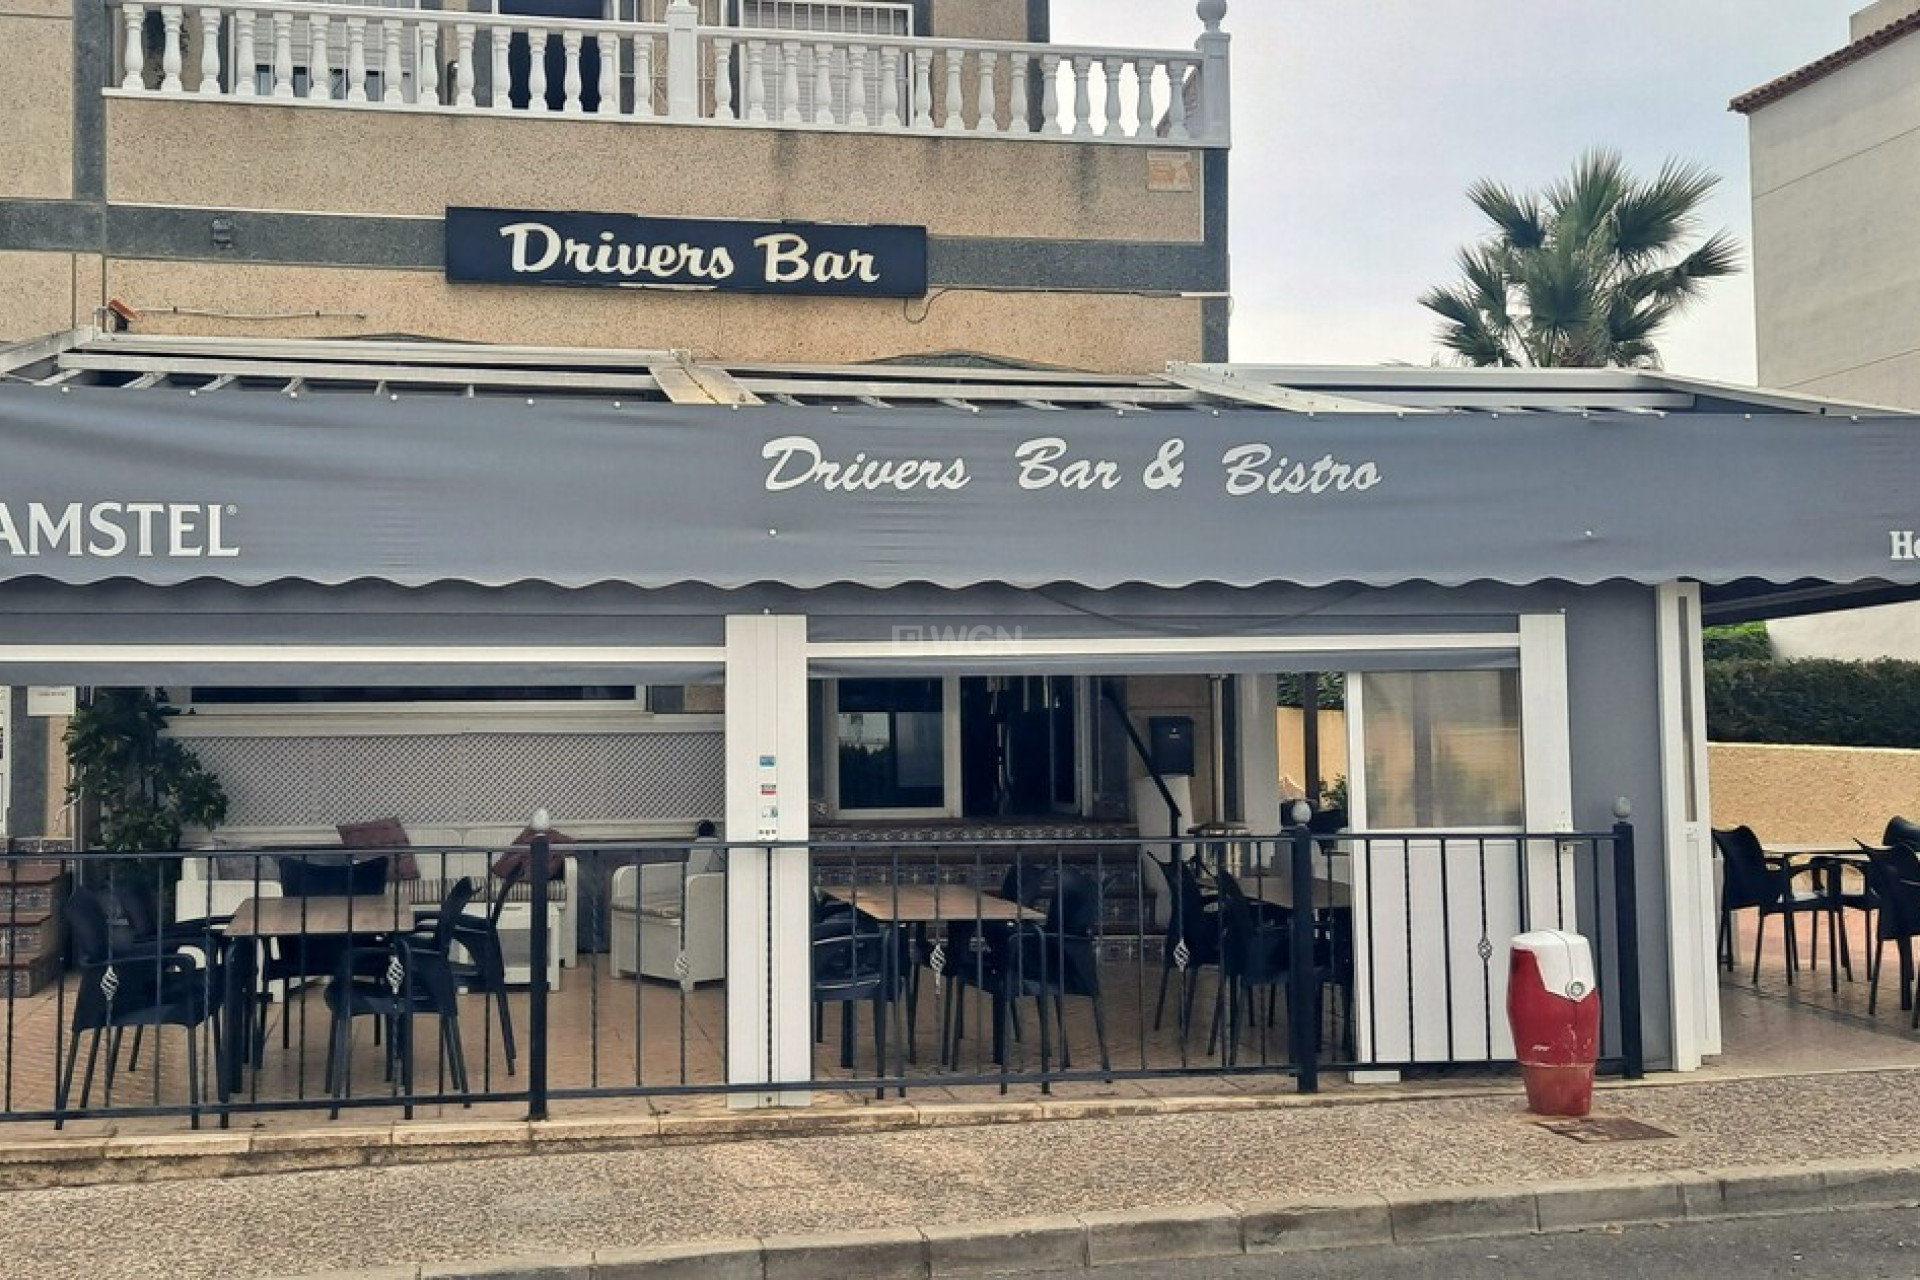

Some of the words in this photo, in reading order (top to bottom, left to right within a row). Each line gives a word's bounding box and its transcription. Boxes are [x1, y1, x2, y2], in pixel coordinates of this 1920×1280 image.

[499, 222, 735, 279] Drivers
[753, 232, 880, 284] Bar
[761, 435, 972, 492] Drivers
[1014, 437, 1122, 491] Bar
[1142, 437, 1186, 490] &
[1221, 443, 1383, 497] Bistro
